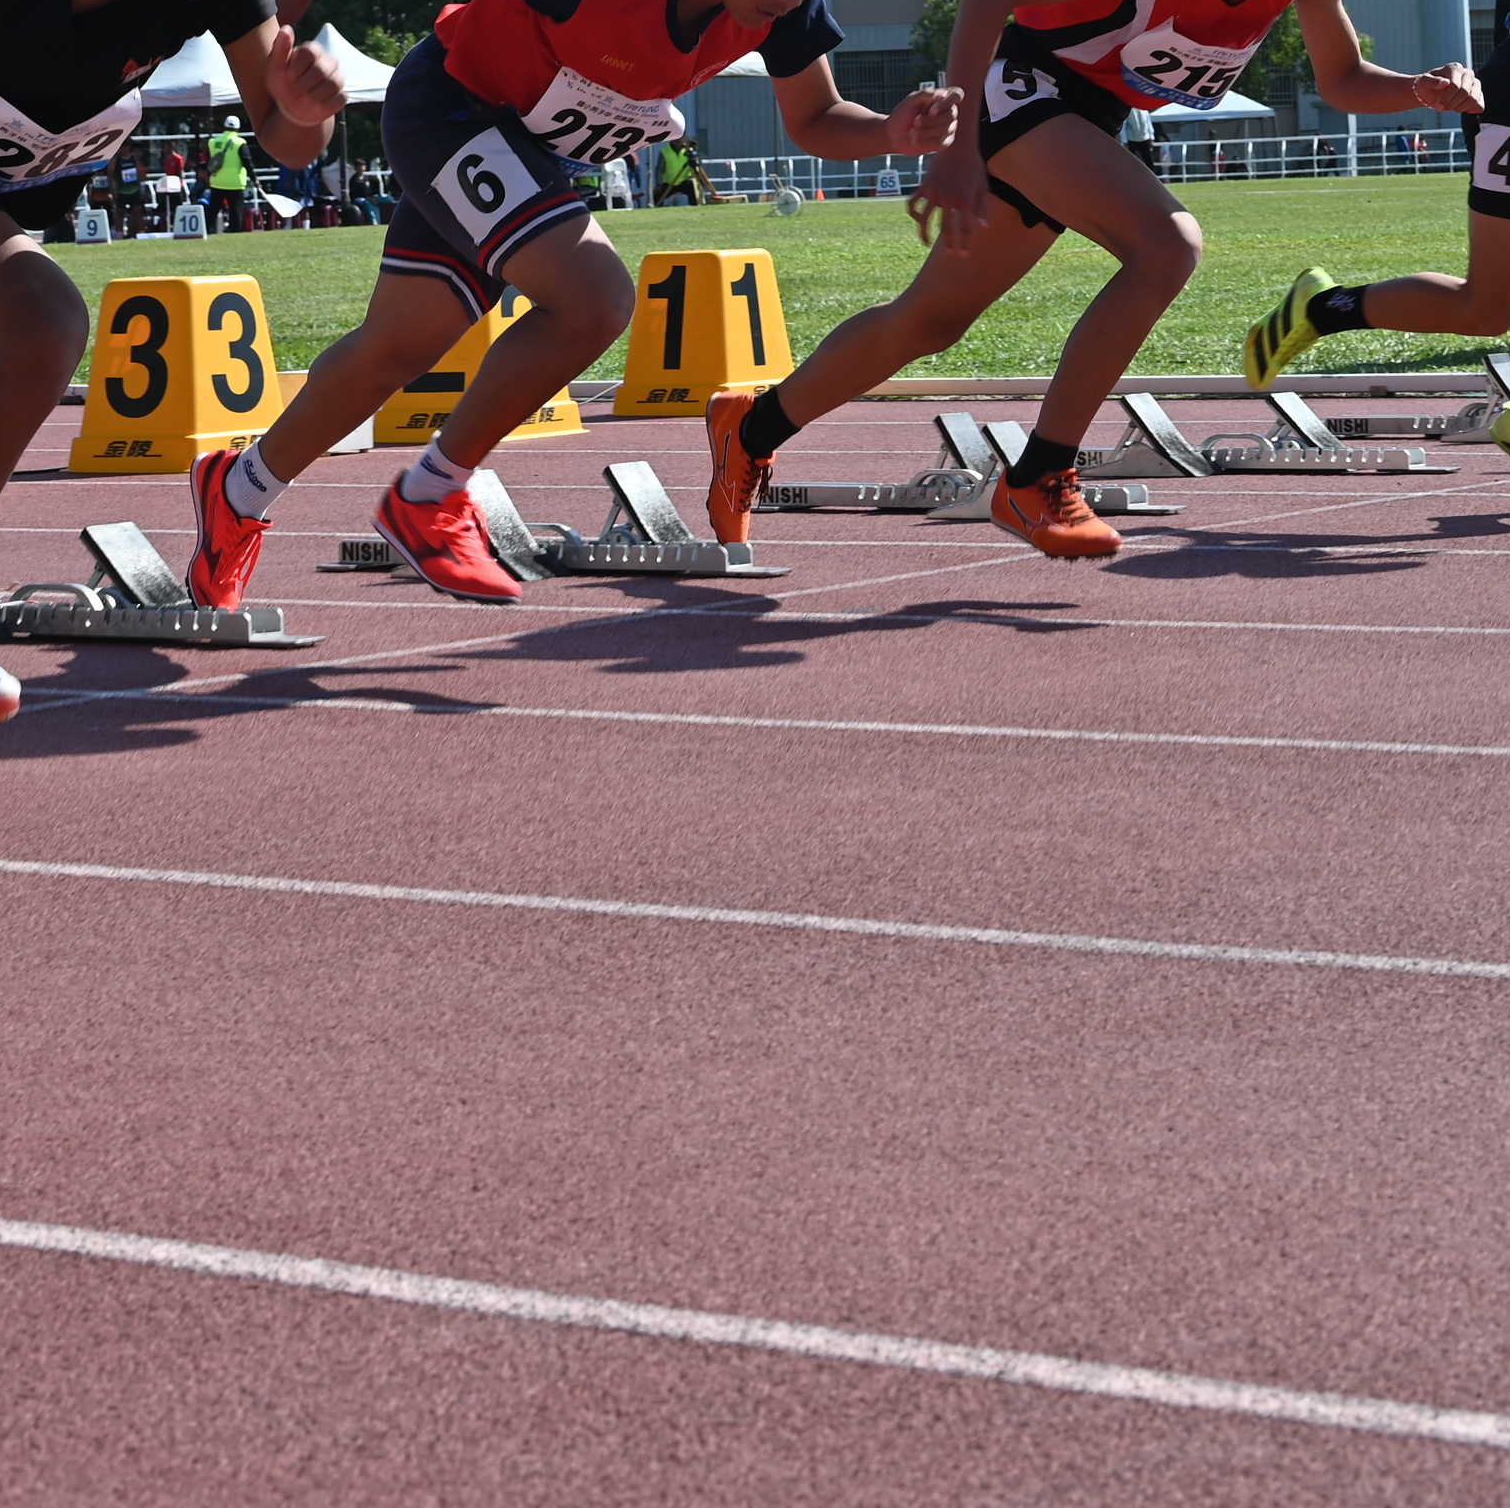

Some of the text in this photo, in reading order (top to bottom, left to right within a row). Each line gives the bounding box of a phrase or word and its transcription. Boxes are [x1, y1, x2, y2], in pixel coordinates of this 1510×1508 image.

[457, 154, 505, 214] 6
[86, 219, 98, 237] 9
[179, 215, 199, 233] 10
[648, 266, 687, 370] 1
[731, 263, 766, 366] 1
[105, 295, 169, 418] 3
[208, 292, 264, 413] 3
[1326, 418, 1368, 433] NISHI
[1077, 451, 1102, 466] SHI
[763, 486, 808, 503] NISHI
[342, 541, 389, 562] NISHI
